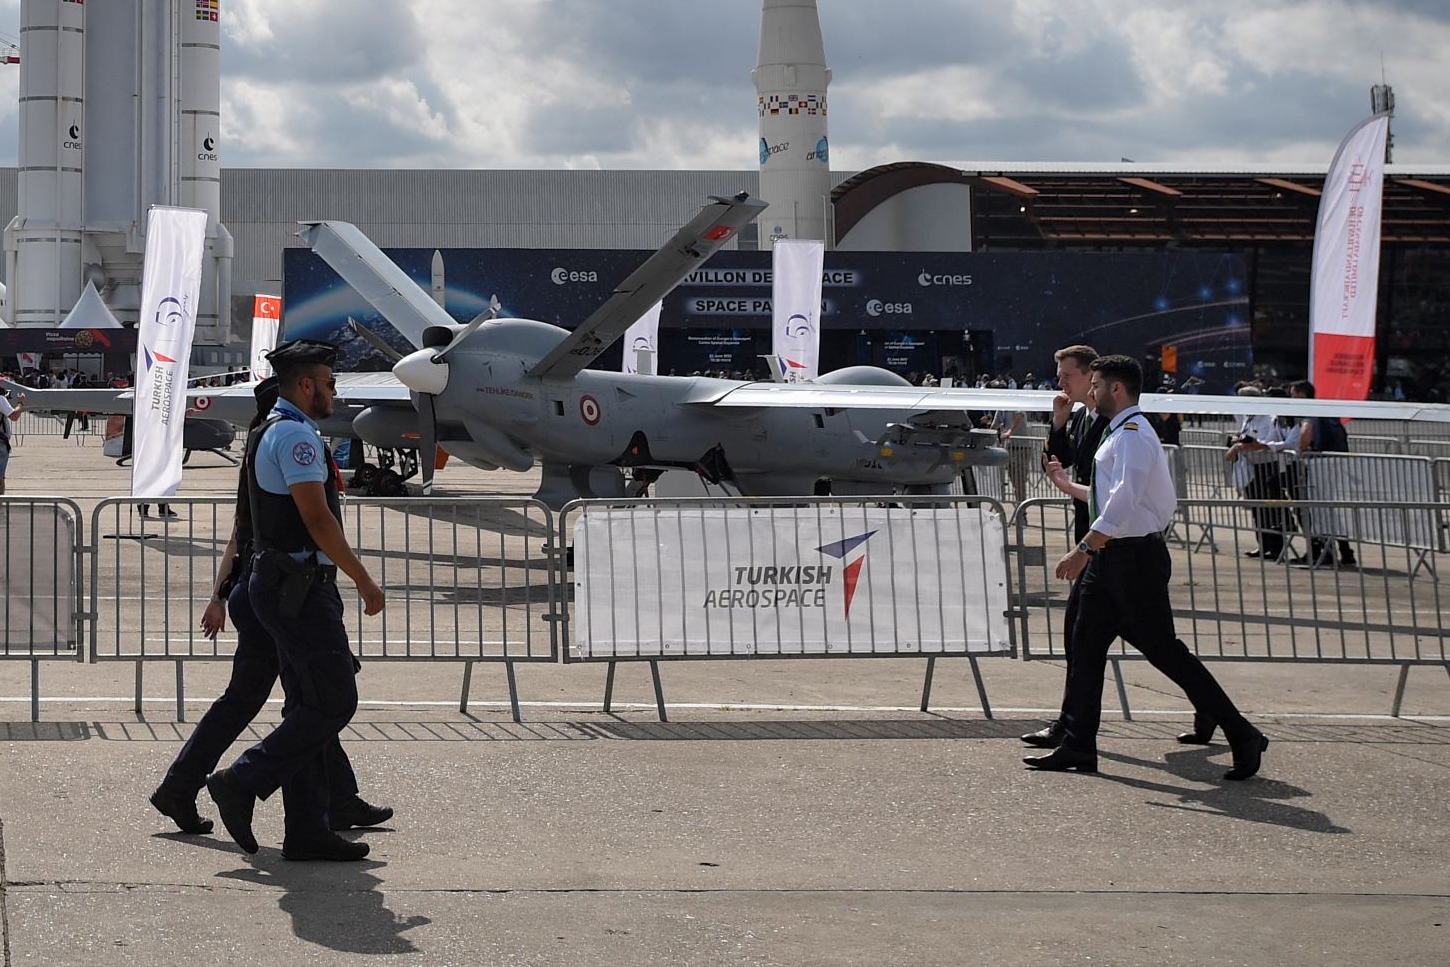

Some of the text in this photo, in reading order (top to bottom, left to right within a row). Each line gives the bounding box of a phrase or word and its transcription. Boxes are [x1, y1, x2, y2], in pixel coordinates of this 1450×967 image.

[197, 153, 217, 161] cnes
[570, 271, 598, 282] esa
[752, 272, 773, 283] DE
[933, 274, 972, 285] cnes
[696, 300, 747, 313] SPACE
[884, 303, 912, 314] esa
[150, 365, 164, 411] TURKISH
[161, 369, 174, 427] AEROSPACE
[734, 565, 833, 585] TURKISH
[703, 589, 826, 609] AEROSPACE
